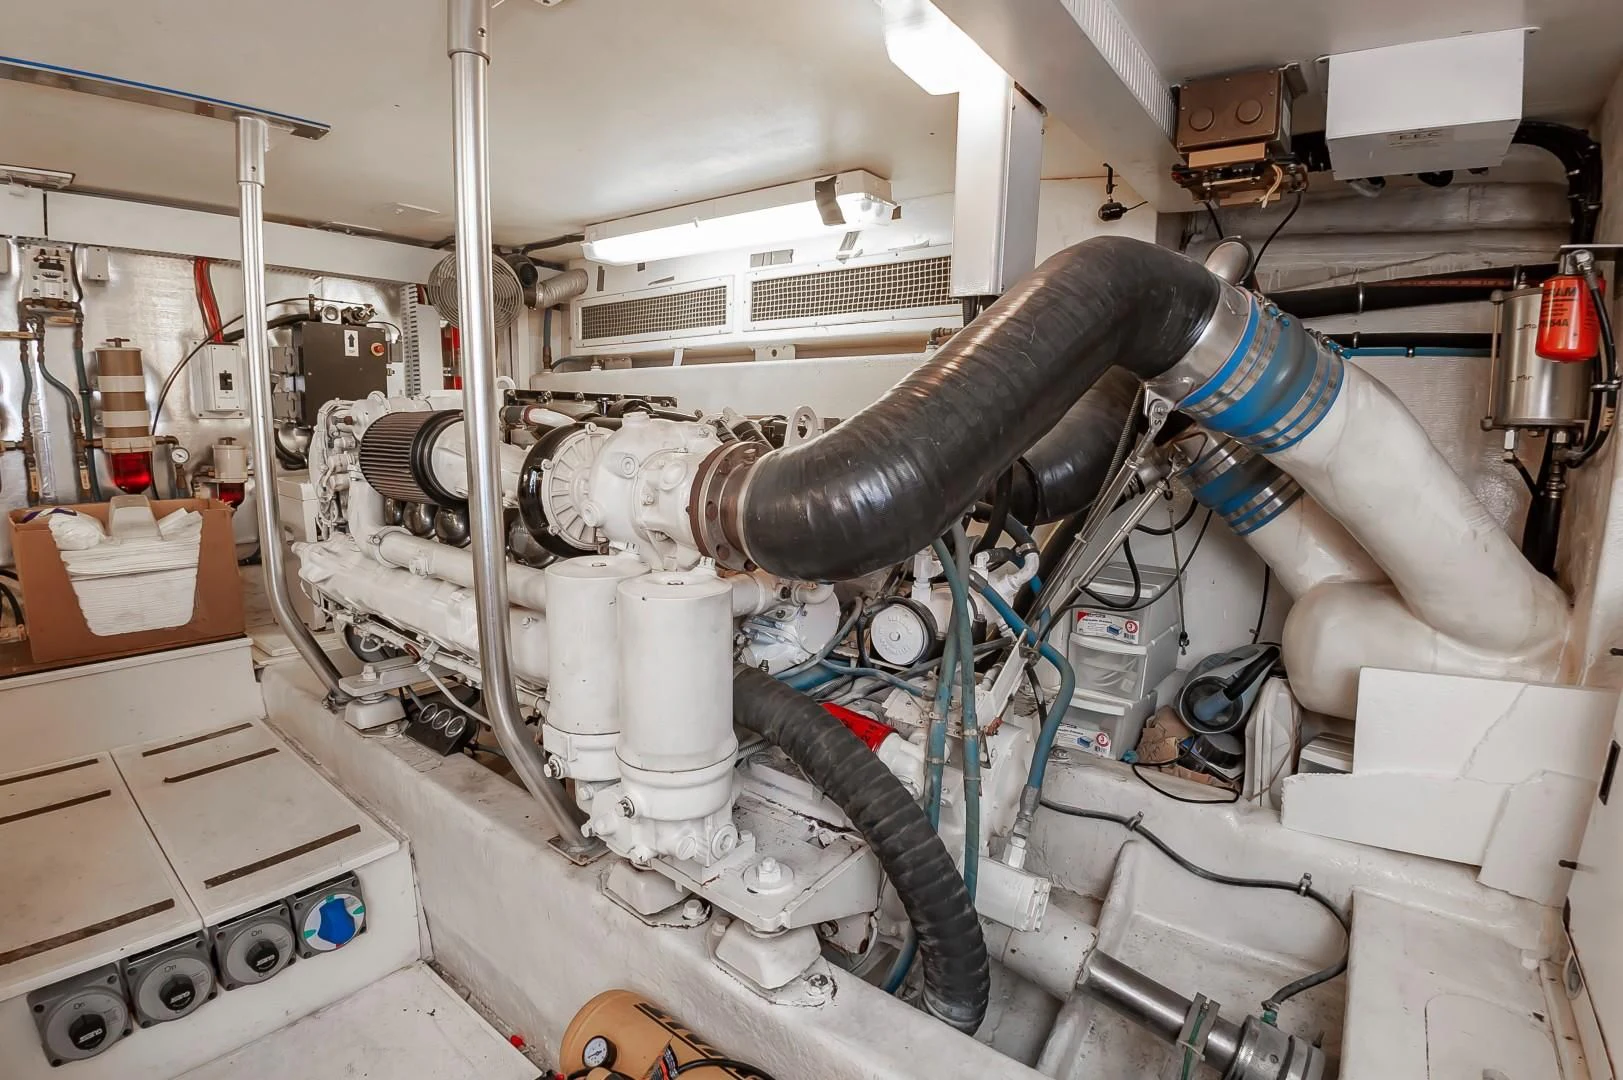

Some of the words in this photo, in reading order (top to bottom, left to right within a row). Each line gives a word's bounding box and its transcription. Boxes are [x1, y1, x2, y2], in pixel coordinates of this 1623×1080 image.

[250, 929, 263, 937] On
[164, 964, 177, 973] On
[73, 1002, 86, 1010] On
